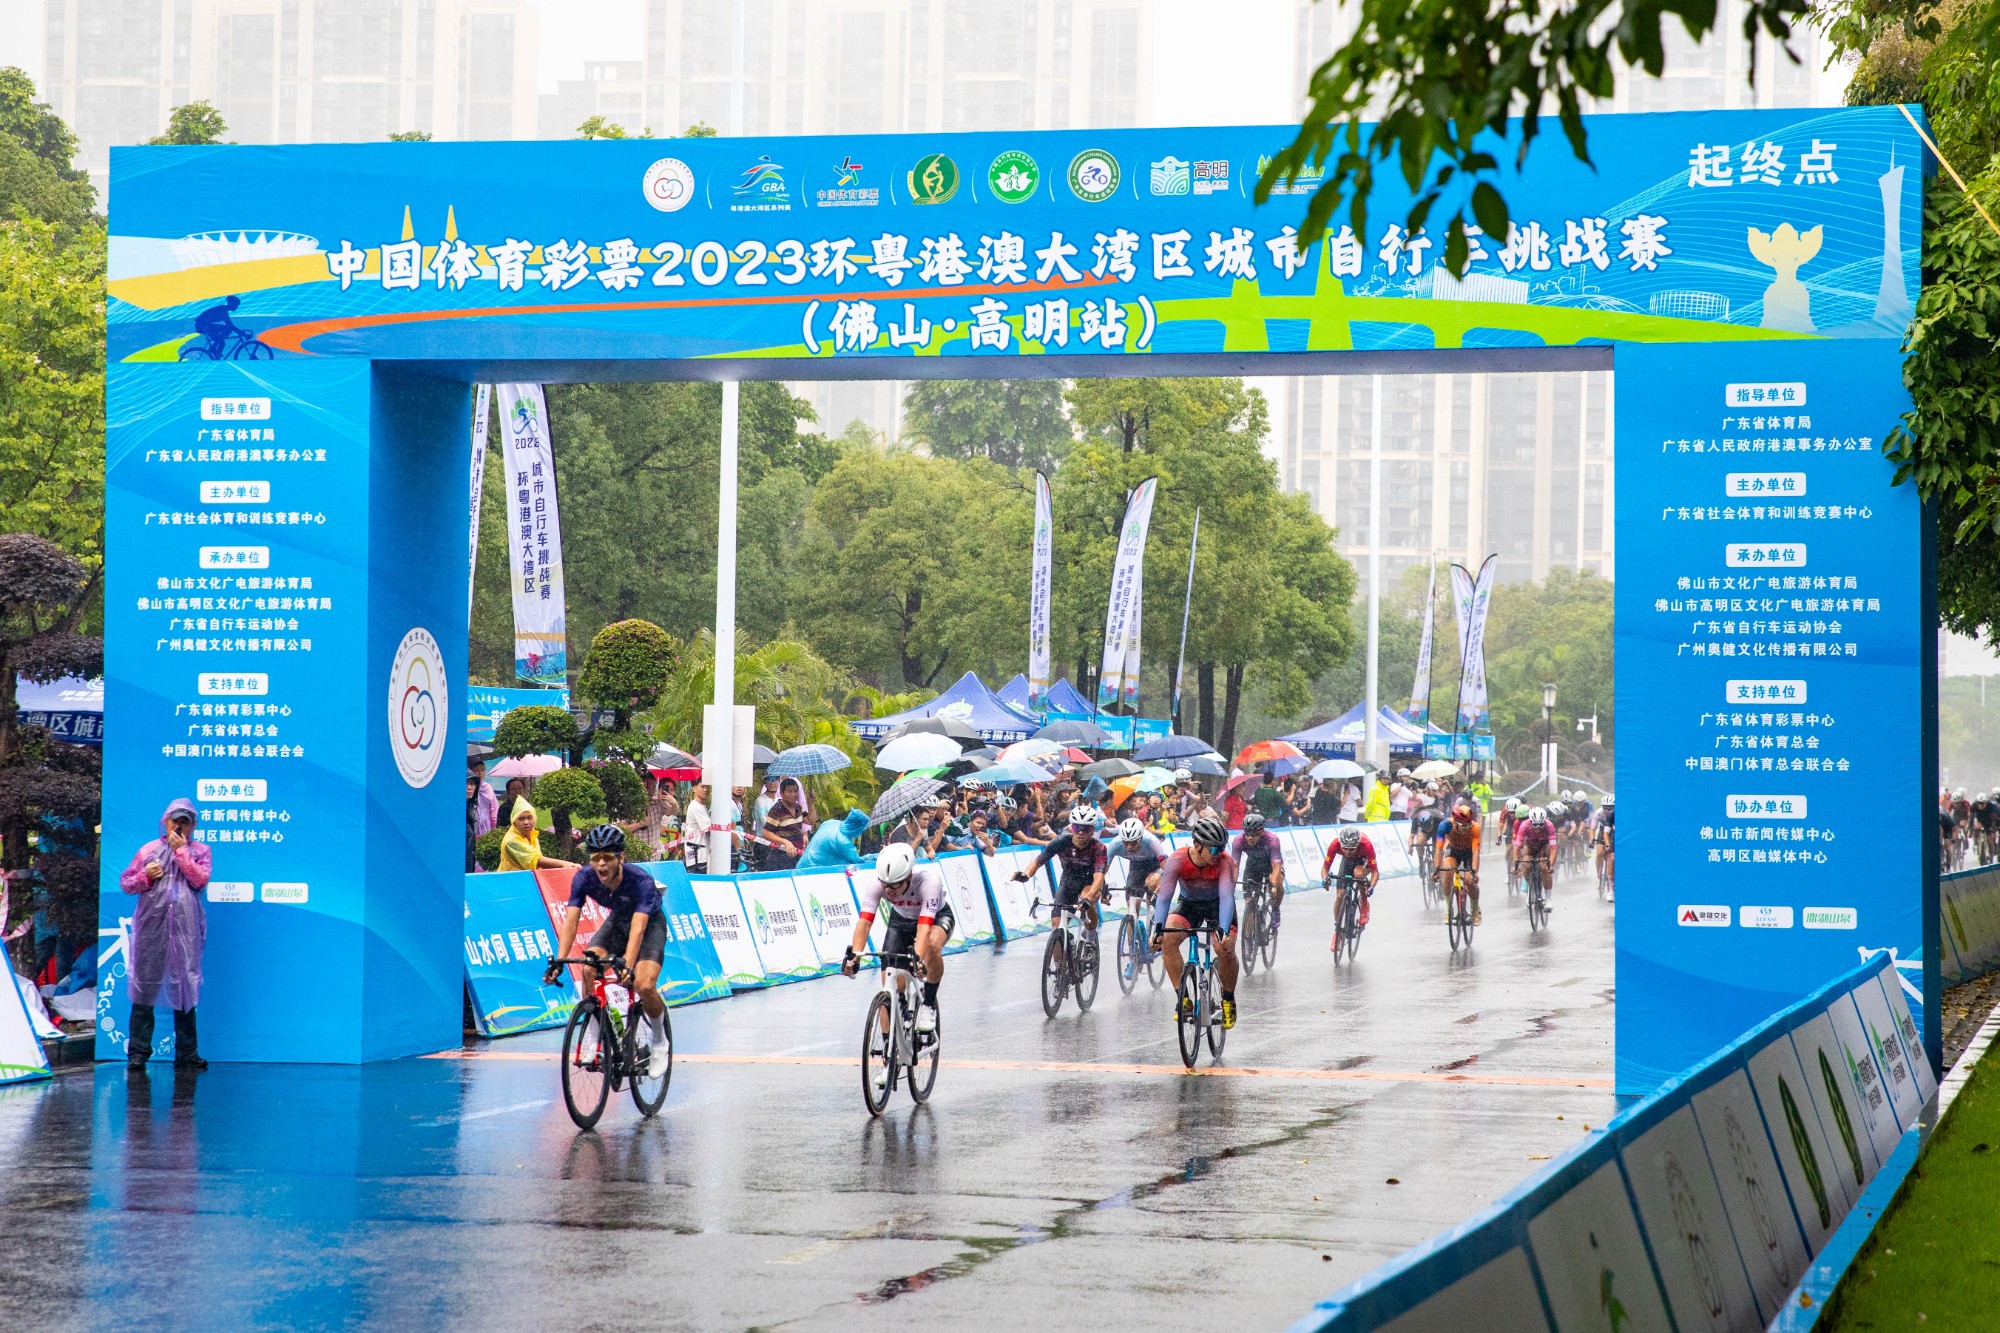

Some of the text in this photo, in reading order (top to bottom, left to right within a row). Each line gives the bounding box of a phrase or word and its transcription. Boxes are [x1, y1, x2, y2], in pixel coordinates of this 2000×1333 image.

[1193, 160, 1228, 179] 高明
[1688, 139, 1839, 189] 起终点
[761, 182, 787, 192] GBA
[817, 188, 879, 201] 中国体育彩票
[1736, 387, 1796, 402] 指导单位
[210, 402, 262, 416] 指导单位
[1721, 415, 1812, 430] 广东省体育局
[197, 428, 275, 442] 广东省体育局
[1662, 437, 1873, 453] 广东省人民政府港澳事务办公室
[145, 448, 327, 462] 广东省人民政府港澳事务办公室
[1736, 477, 1796, 492] 主办单位
[209, 486, 261, 499] 主办单位
[144, 511, 327, 526] 广东省社会体育和训练竞赛中心
[1662, 506, 1873, 521] 广东省社会体育和训练竞赛中心
[517, 471, 536, 594] 环粤港澳大湾区
[531, 460, 552, 601] 城市自行车挑战赛
[209, 551, 260, 564] 承办单位
[1736, 548, 1796, 562] 承办单位
[156, 576, 313, 591] 佛山市文化广电旅游体育局
[1677, 575, 1858, 590] 佛山市文化广电旅游体育局
[137, 597, 332, 611] 佛山市高明区文化广电旅游体育局
[1655, 597, 1881, 613] 佛山市高明区文化广电旅游体育局
[169, 617, 299, 632] 广东省自行车运动协会
[1692, 620, 1843, 634] 广东省自行车运动协会
[156, 638, 312, 652] 广州奥健文化传播有限公司
[1677, 642, 1858, 657] 广州奥健文化传播有限公司
[208, 677, 259, 691] 支持单位
[1737, 685, 1796, 699] 支持单位
[175, 703, 292, 717] 广东省体育彩票中心
[1699, 712, 1835, 727] 广东省体育彩票中心
[188, 724, 278, 737] 广东省体育总会
[1715, 735, 1820, 750] 广东省体育总会
[162, 744, 305, 758] 中国澳门体育总会联合会
[1685, 756, 1851, 771] 中国澳门体育总会联合会
[203, 784, 255, 797] 协办单位
[1734, 799, 1793, 814] 协办单位
[200, 808, 291, 822] 市新闻传媒中心
[193, 829, 284, 843] 明区融媒体中心
[1699, 827, 1836, 842] 佛山市新闻传媒中心
[1707, 849, 1828, 864] 高明区融媒体中心
[1805, 912, 1851, 924] 鼎湖山泉
[670, 912, 706, 942] 最高明
[464, 928, 554, 967] 山水间 最高明
